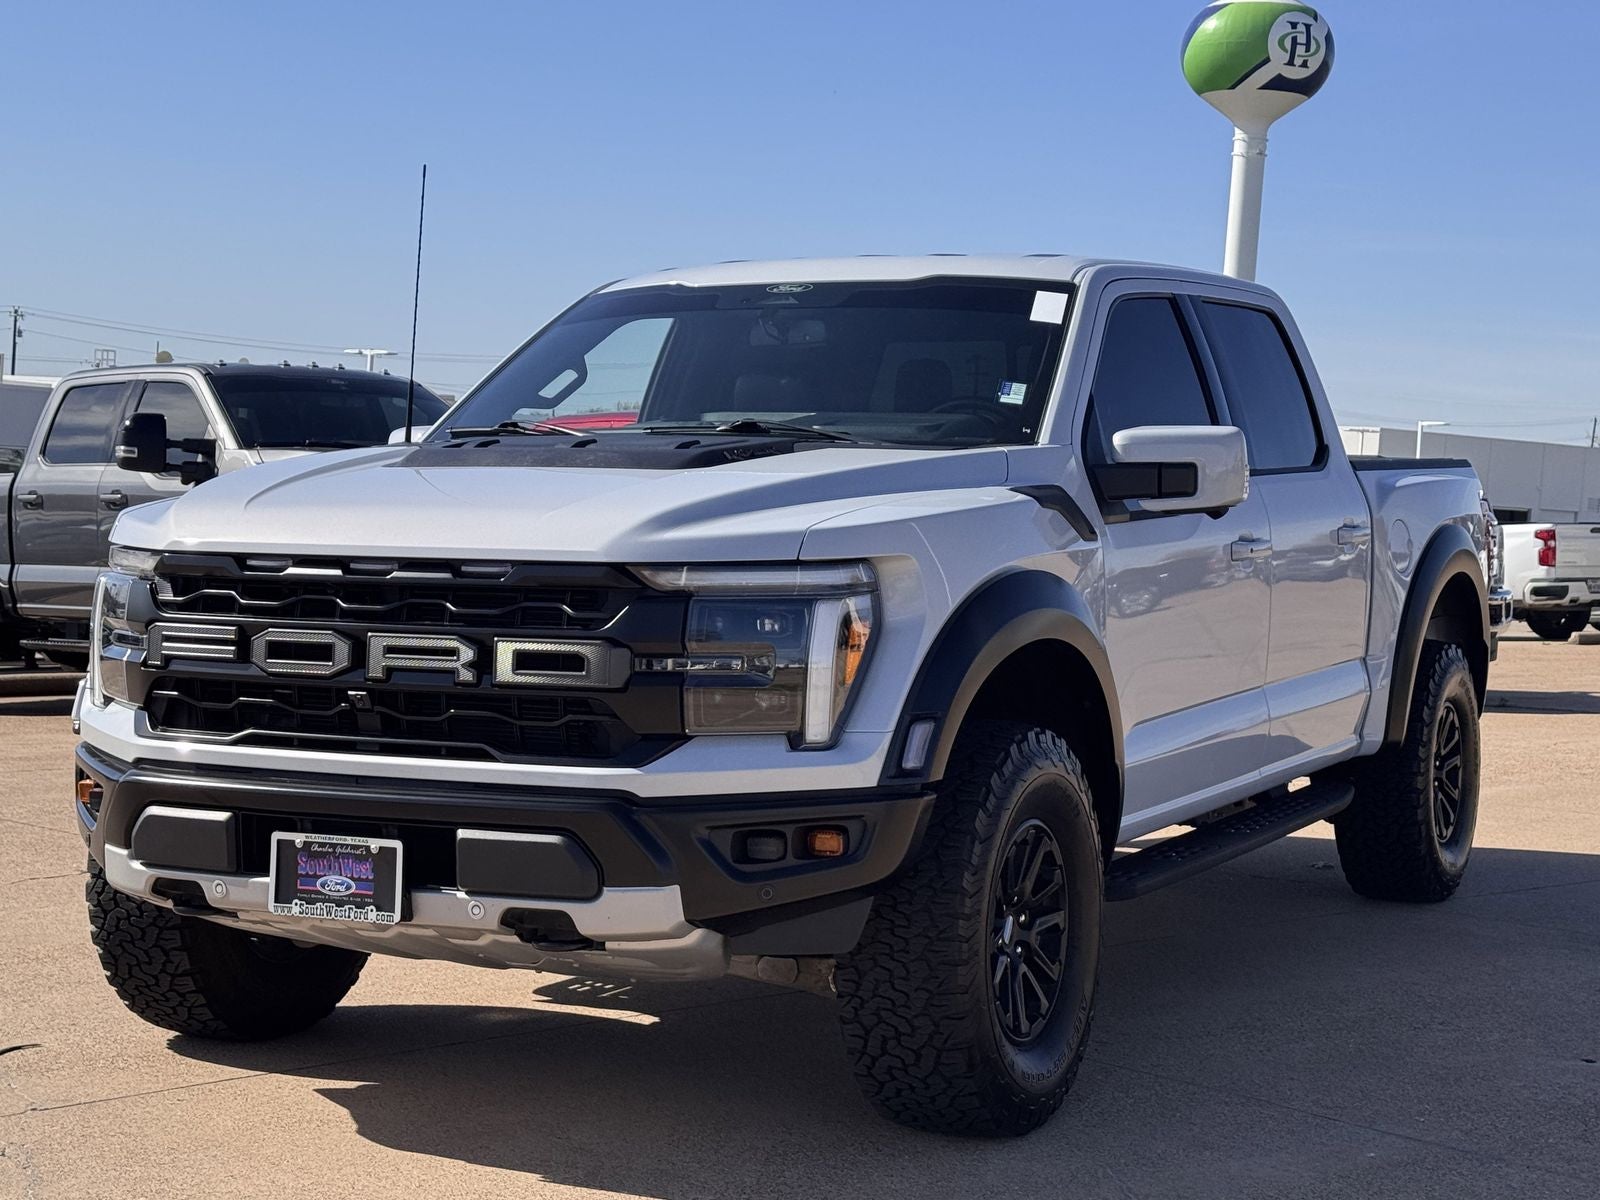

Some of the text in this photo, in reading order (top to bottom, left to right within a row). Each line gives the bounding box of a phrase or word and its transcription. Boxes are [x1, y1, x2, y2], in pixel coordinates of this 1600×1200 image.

[146, 622, 628, 688] FORD
[324, 879, 347, 892] Ford
[273, 902, 394, 923] www.SouthWestFord.com
